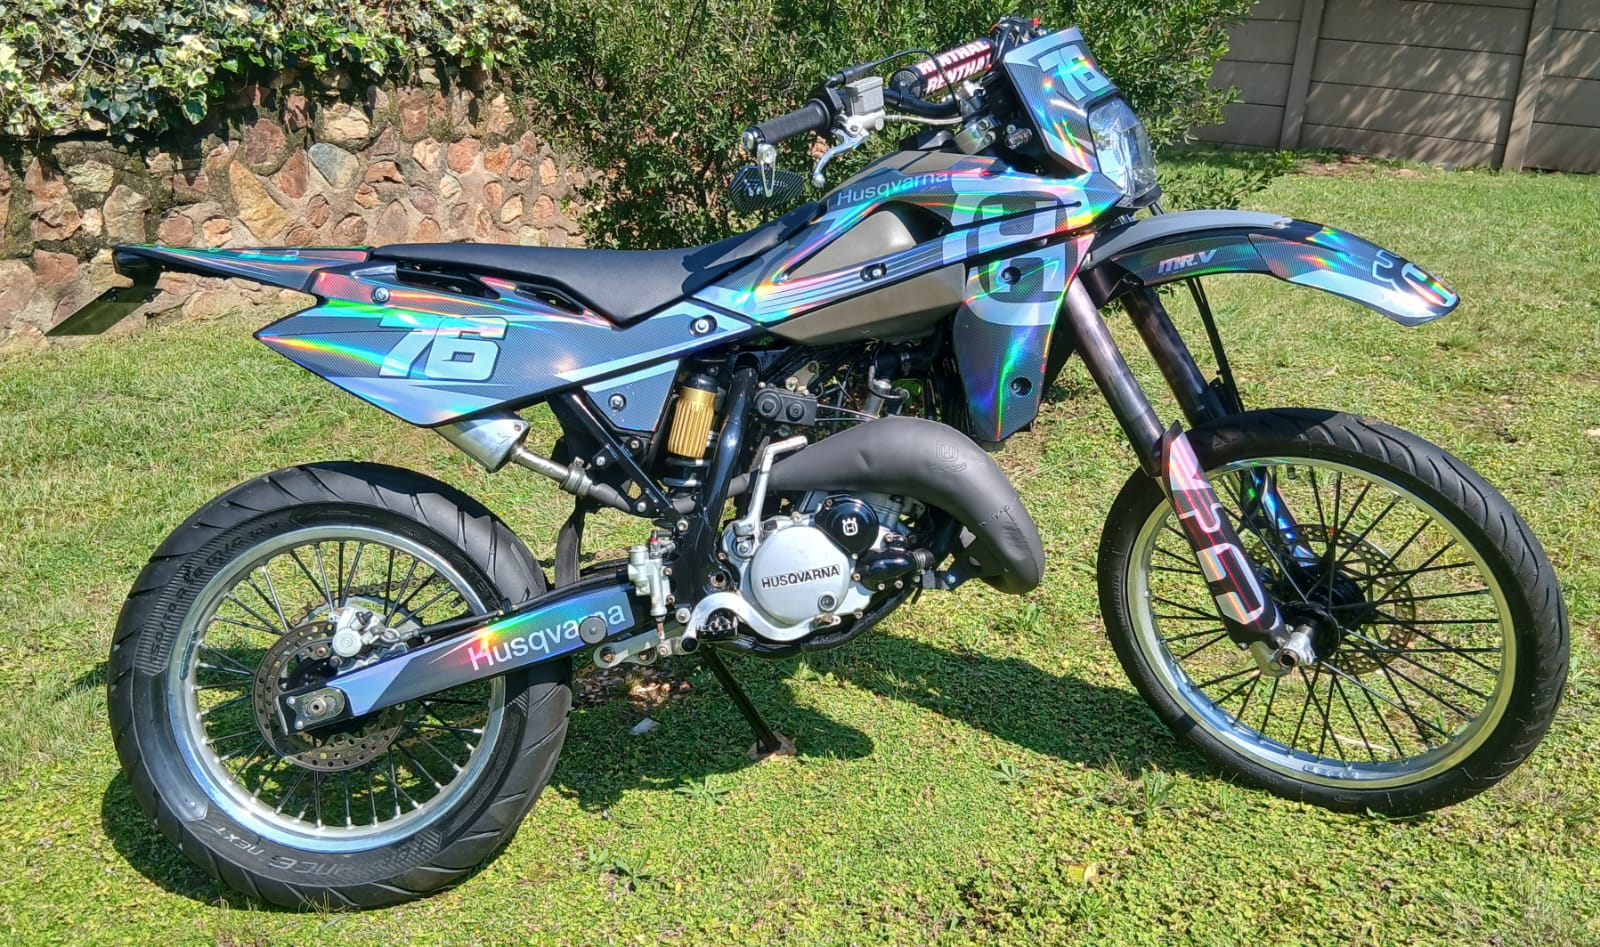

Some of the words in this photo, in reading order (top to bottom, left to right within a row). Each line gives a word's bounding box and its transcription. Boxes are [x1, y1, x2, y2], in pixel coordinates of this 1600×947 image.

[1038, 44, 1110, 101] 76
[836, 173, 949, 206] Husqvarna
[379, 314, 509, 381] 76
[761, 565, 840, 589] HUSQVARNA
[467, 604, 626, 671] Husqvaa
